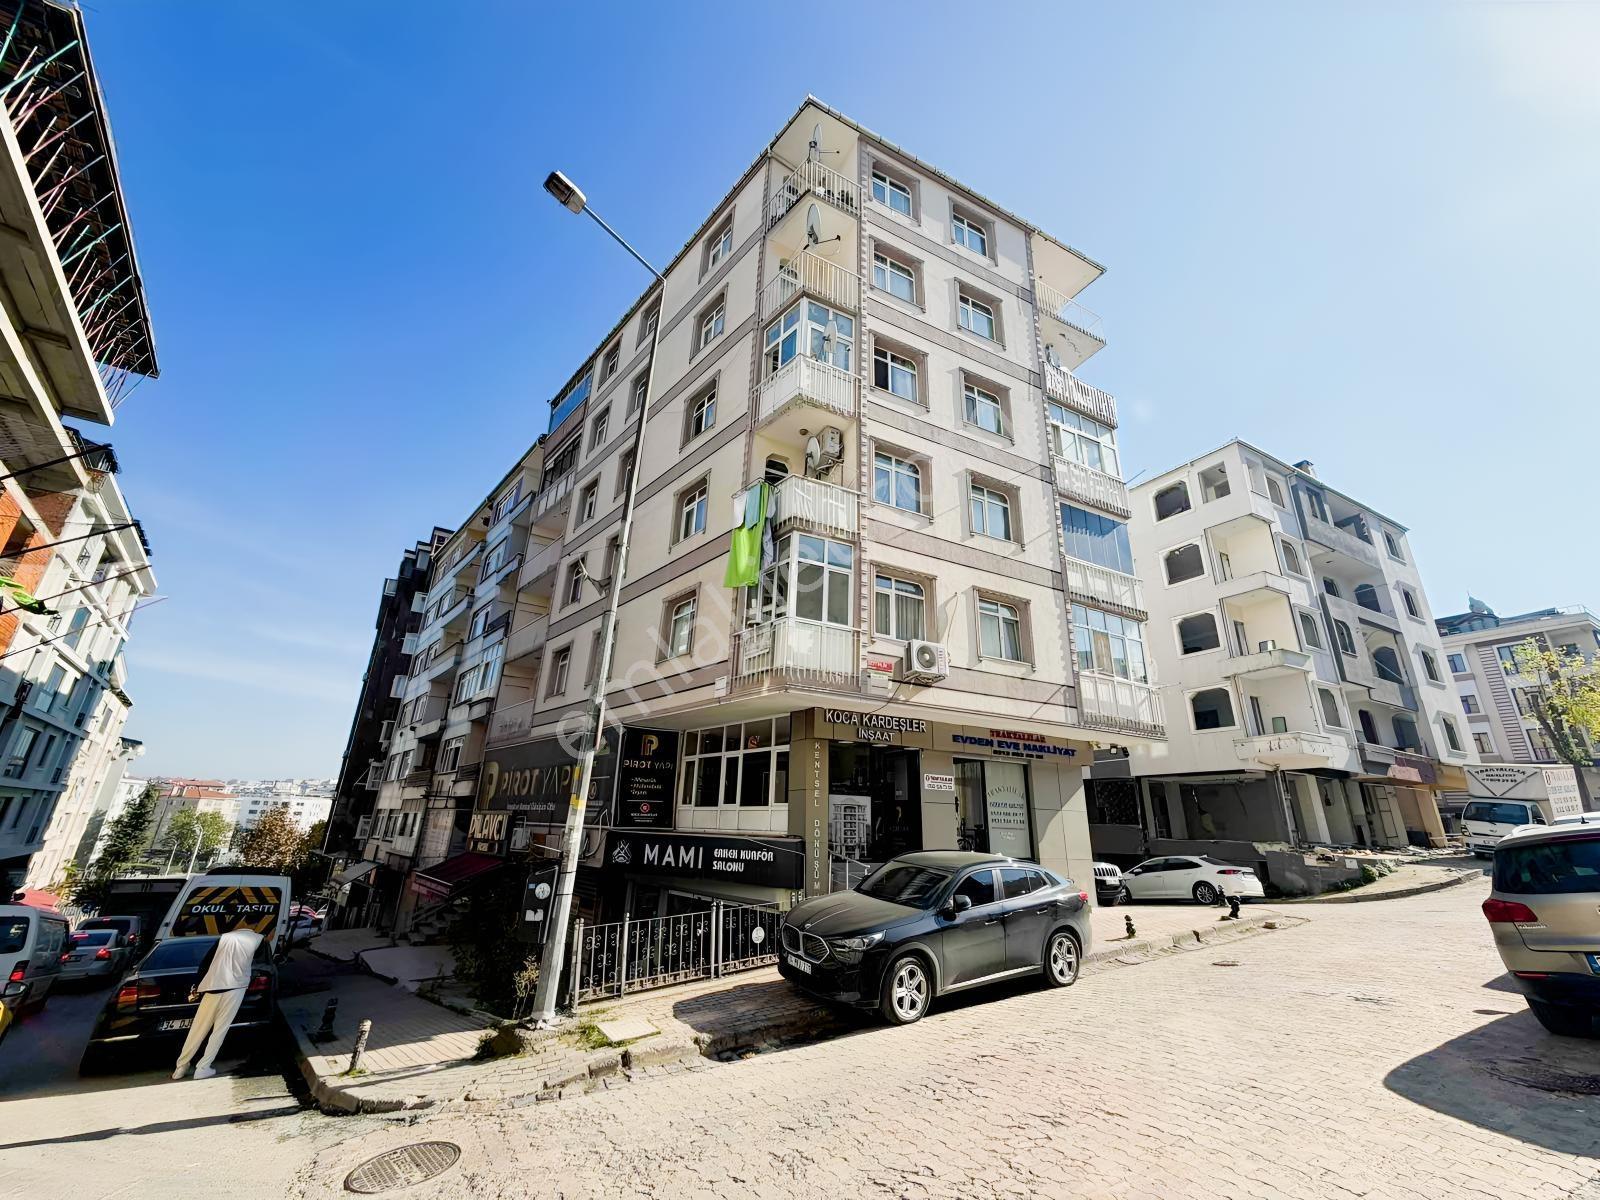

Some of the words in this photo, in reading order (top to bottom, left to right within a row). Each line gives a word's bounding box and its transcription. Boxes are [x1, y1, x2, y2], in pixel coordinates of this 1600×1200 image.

[825, 709, 859, 726] KOCA
[863, 714, 927, 733] KARDEŞLER
[952, 734, 994, 747] EVDEN
[997, 740, 1020, 750] EVE
[1023, 743, 1077, 756] NAKLİYAT
[542, 764, 578, 795] YAP
[643, 843, 704, 869] MAMI
[712, 860, 745, 873] SALONU
[191, 904, 227, 913] OKUL
